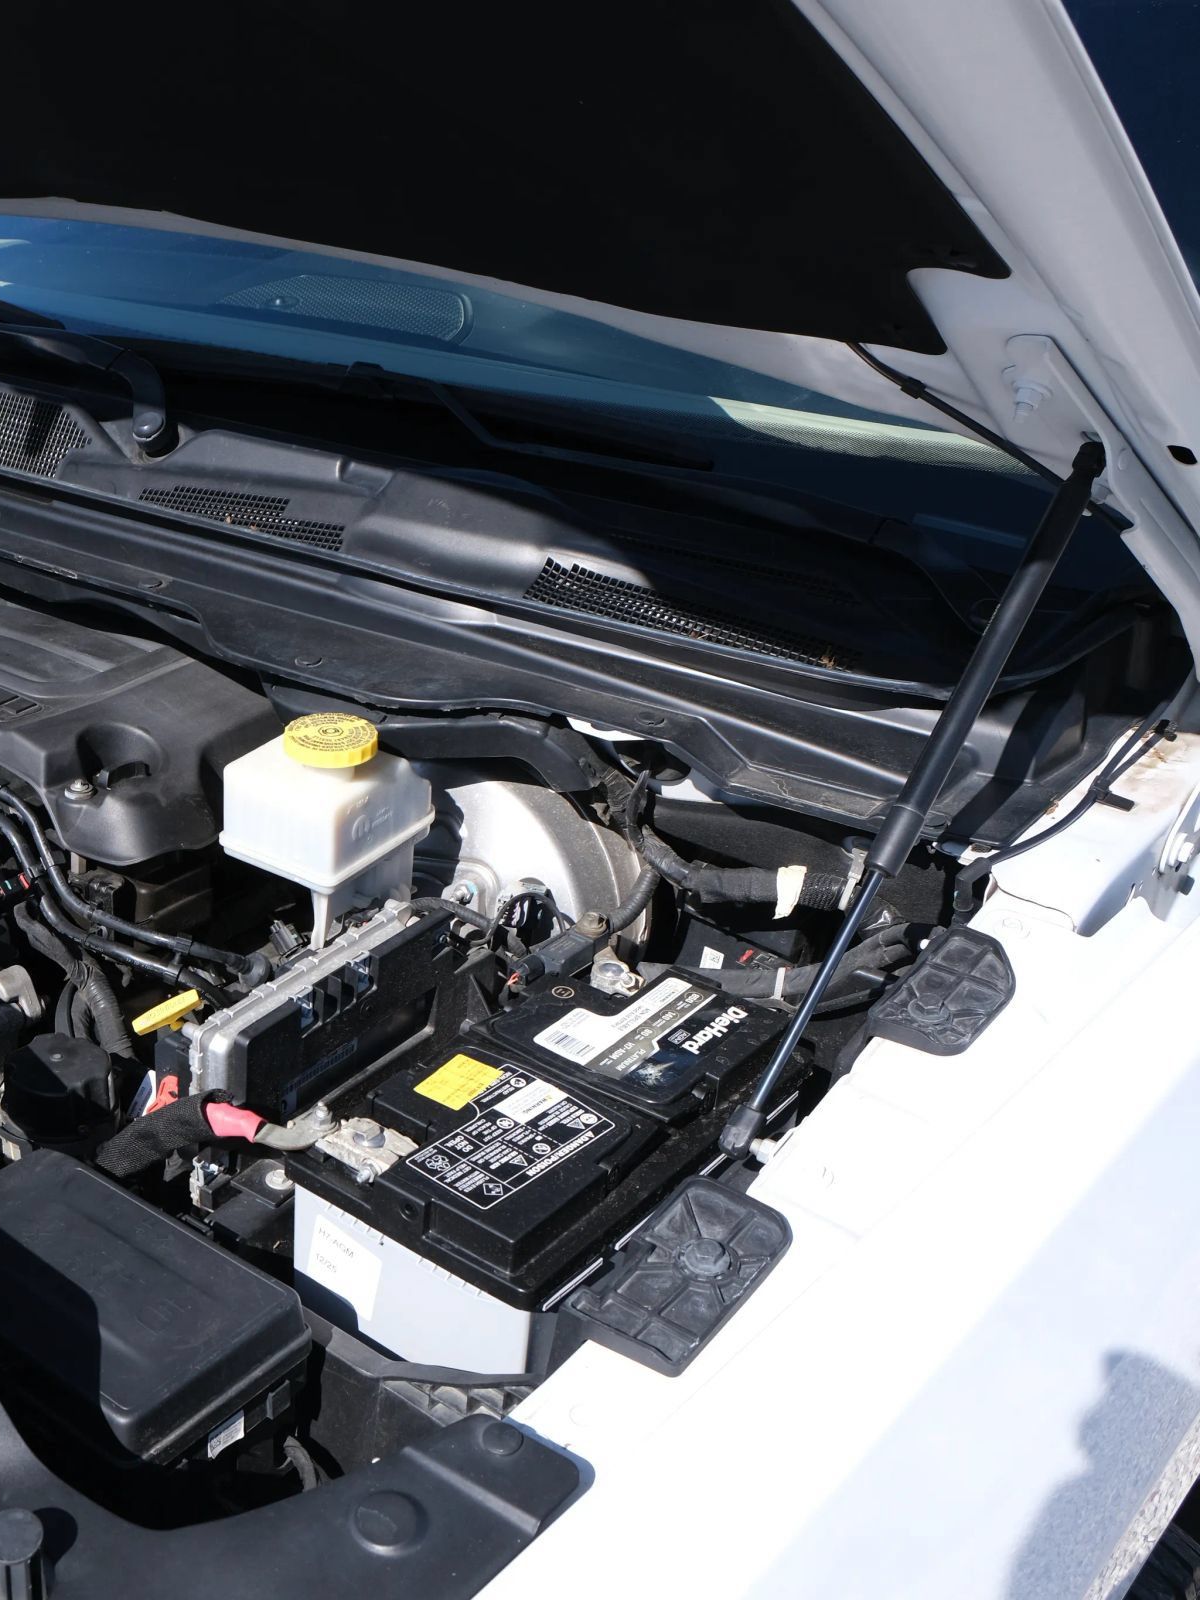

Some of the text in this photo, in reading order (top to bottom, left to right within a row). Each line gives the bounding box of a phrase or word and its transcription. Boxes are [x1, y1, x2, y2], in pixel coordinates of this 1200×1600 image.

[681, 1006, 748, 1054] DieHard
[615, 1049, 646, 1071] PLATINUM
[454, 1140, 469, 1150] NOT
[525, 1135, 590, 1176] DANGER/POISON
